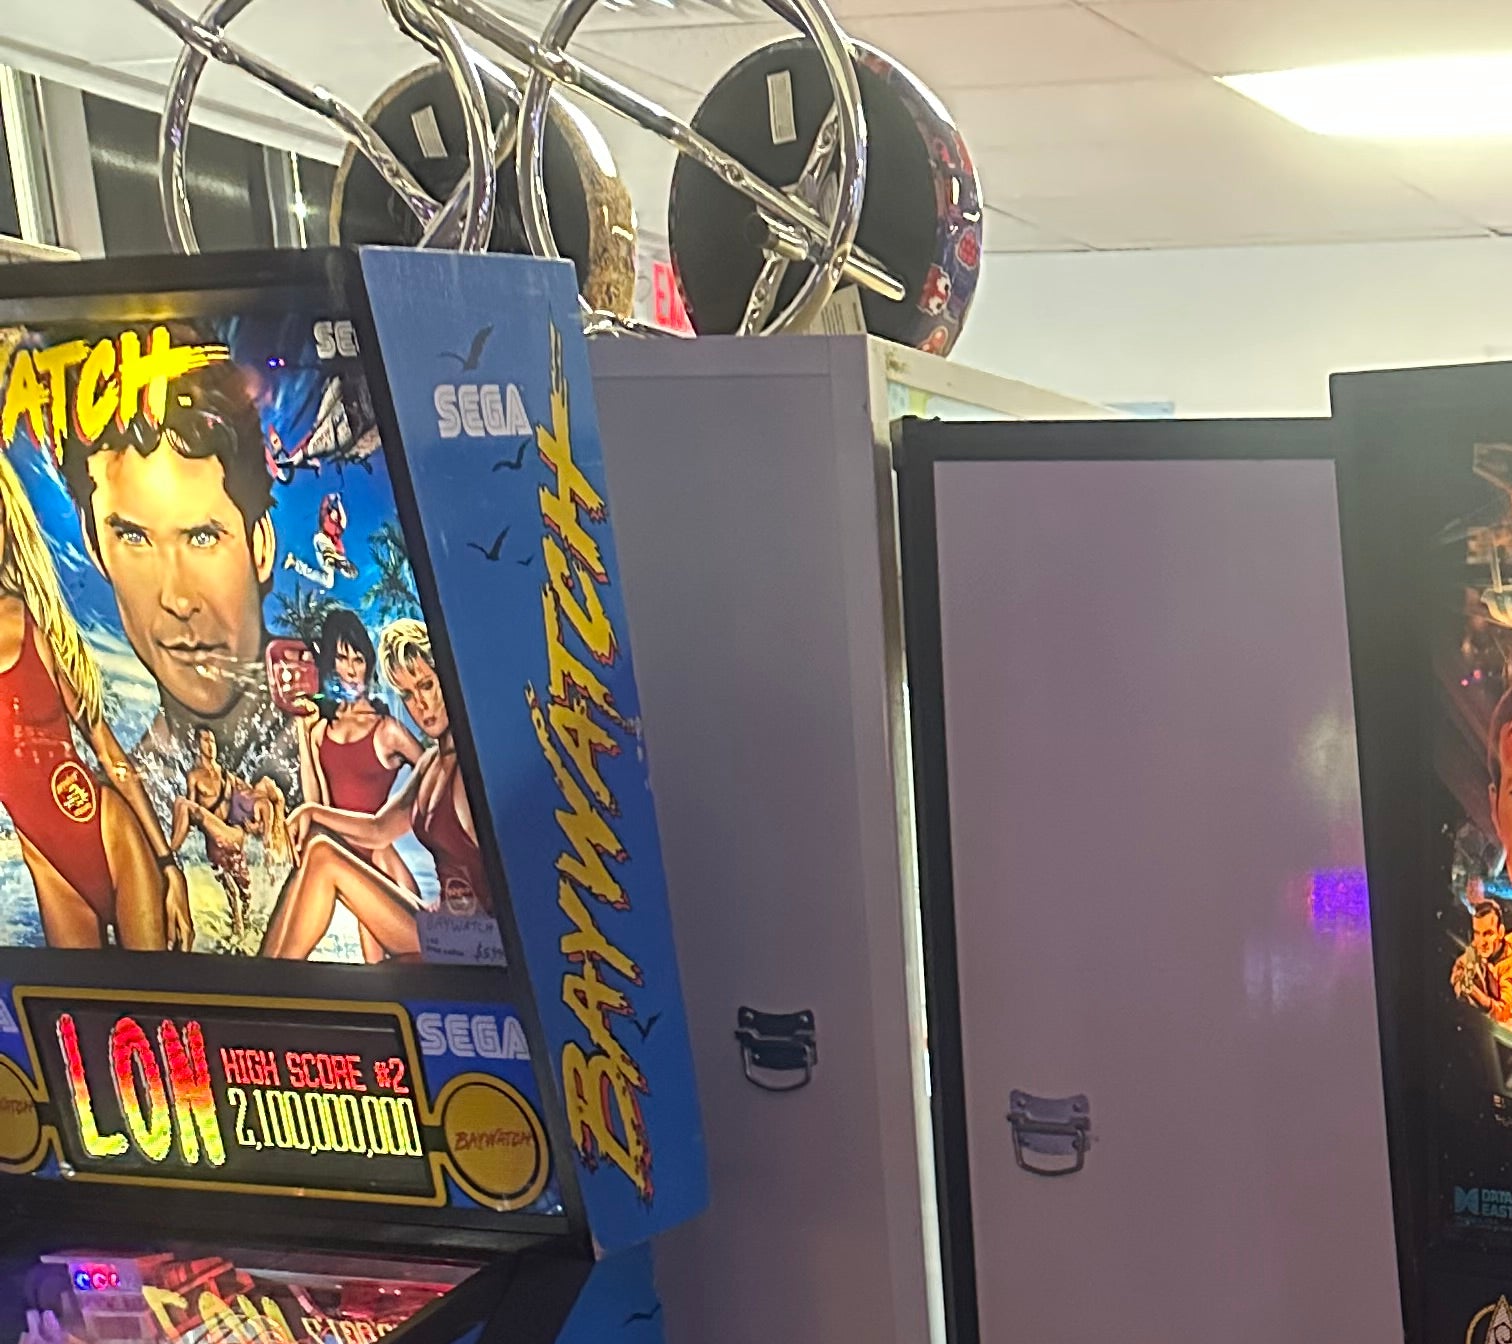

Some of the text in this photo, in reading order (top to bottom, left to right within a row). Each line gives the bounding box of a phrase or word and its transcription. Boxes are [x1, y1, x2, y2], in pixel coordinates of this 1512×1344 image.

[313, 320, 359, 359] SE
[433, 383, 533, 438] SEGA
[524, 316, 653, 1204] BAYWATCH
[415, 1012, 532, 1061] SEGA
[56, 1012, 226, 1167] LON
[220, 1047, 410, 1094] HIGH SCORE #2
[228, 1087, 423, 1158] 2,100,000,000
[455, 1128, 533, 1152] BAYWATCH
